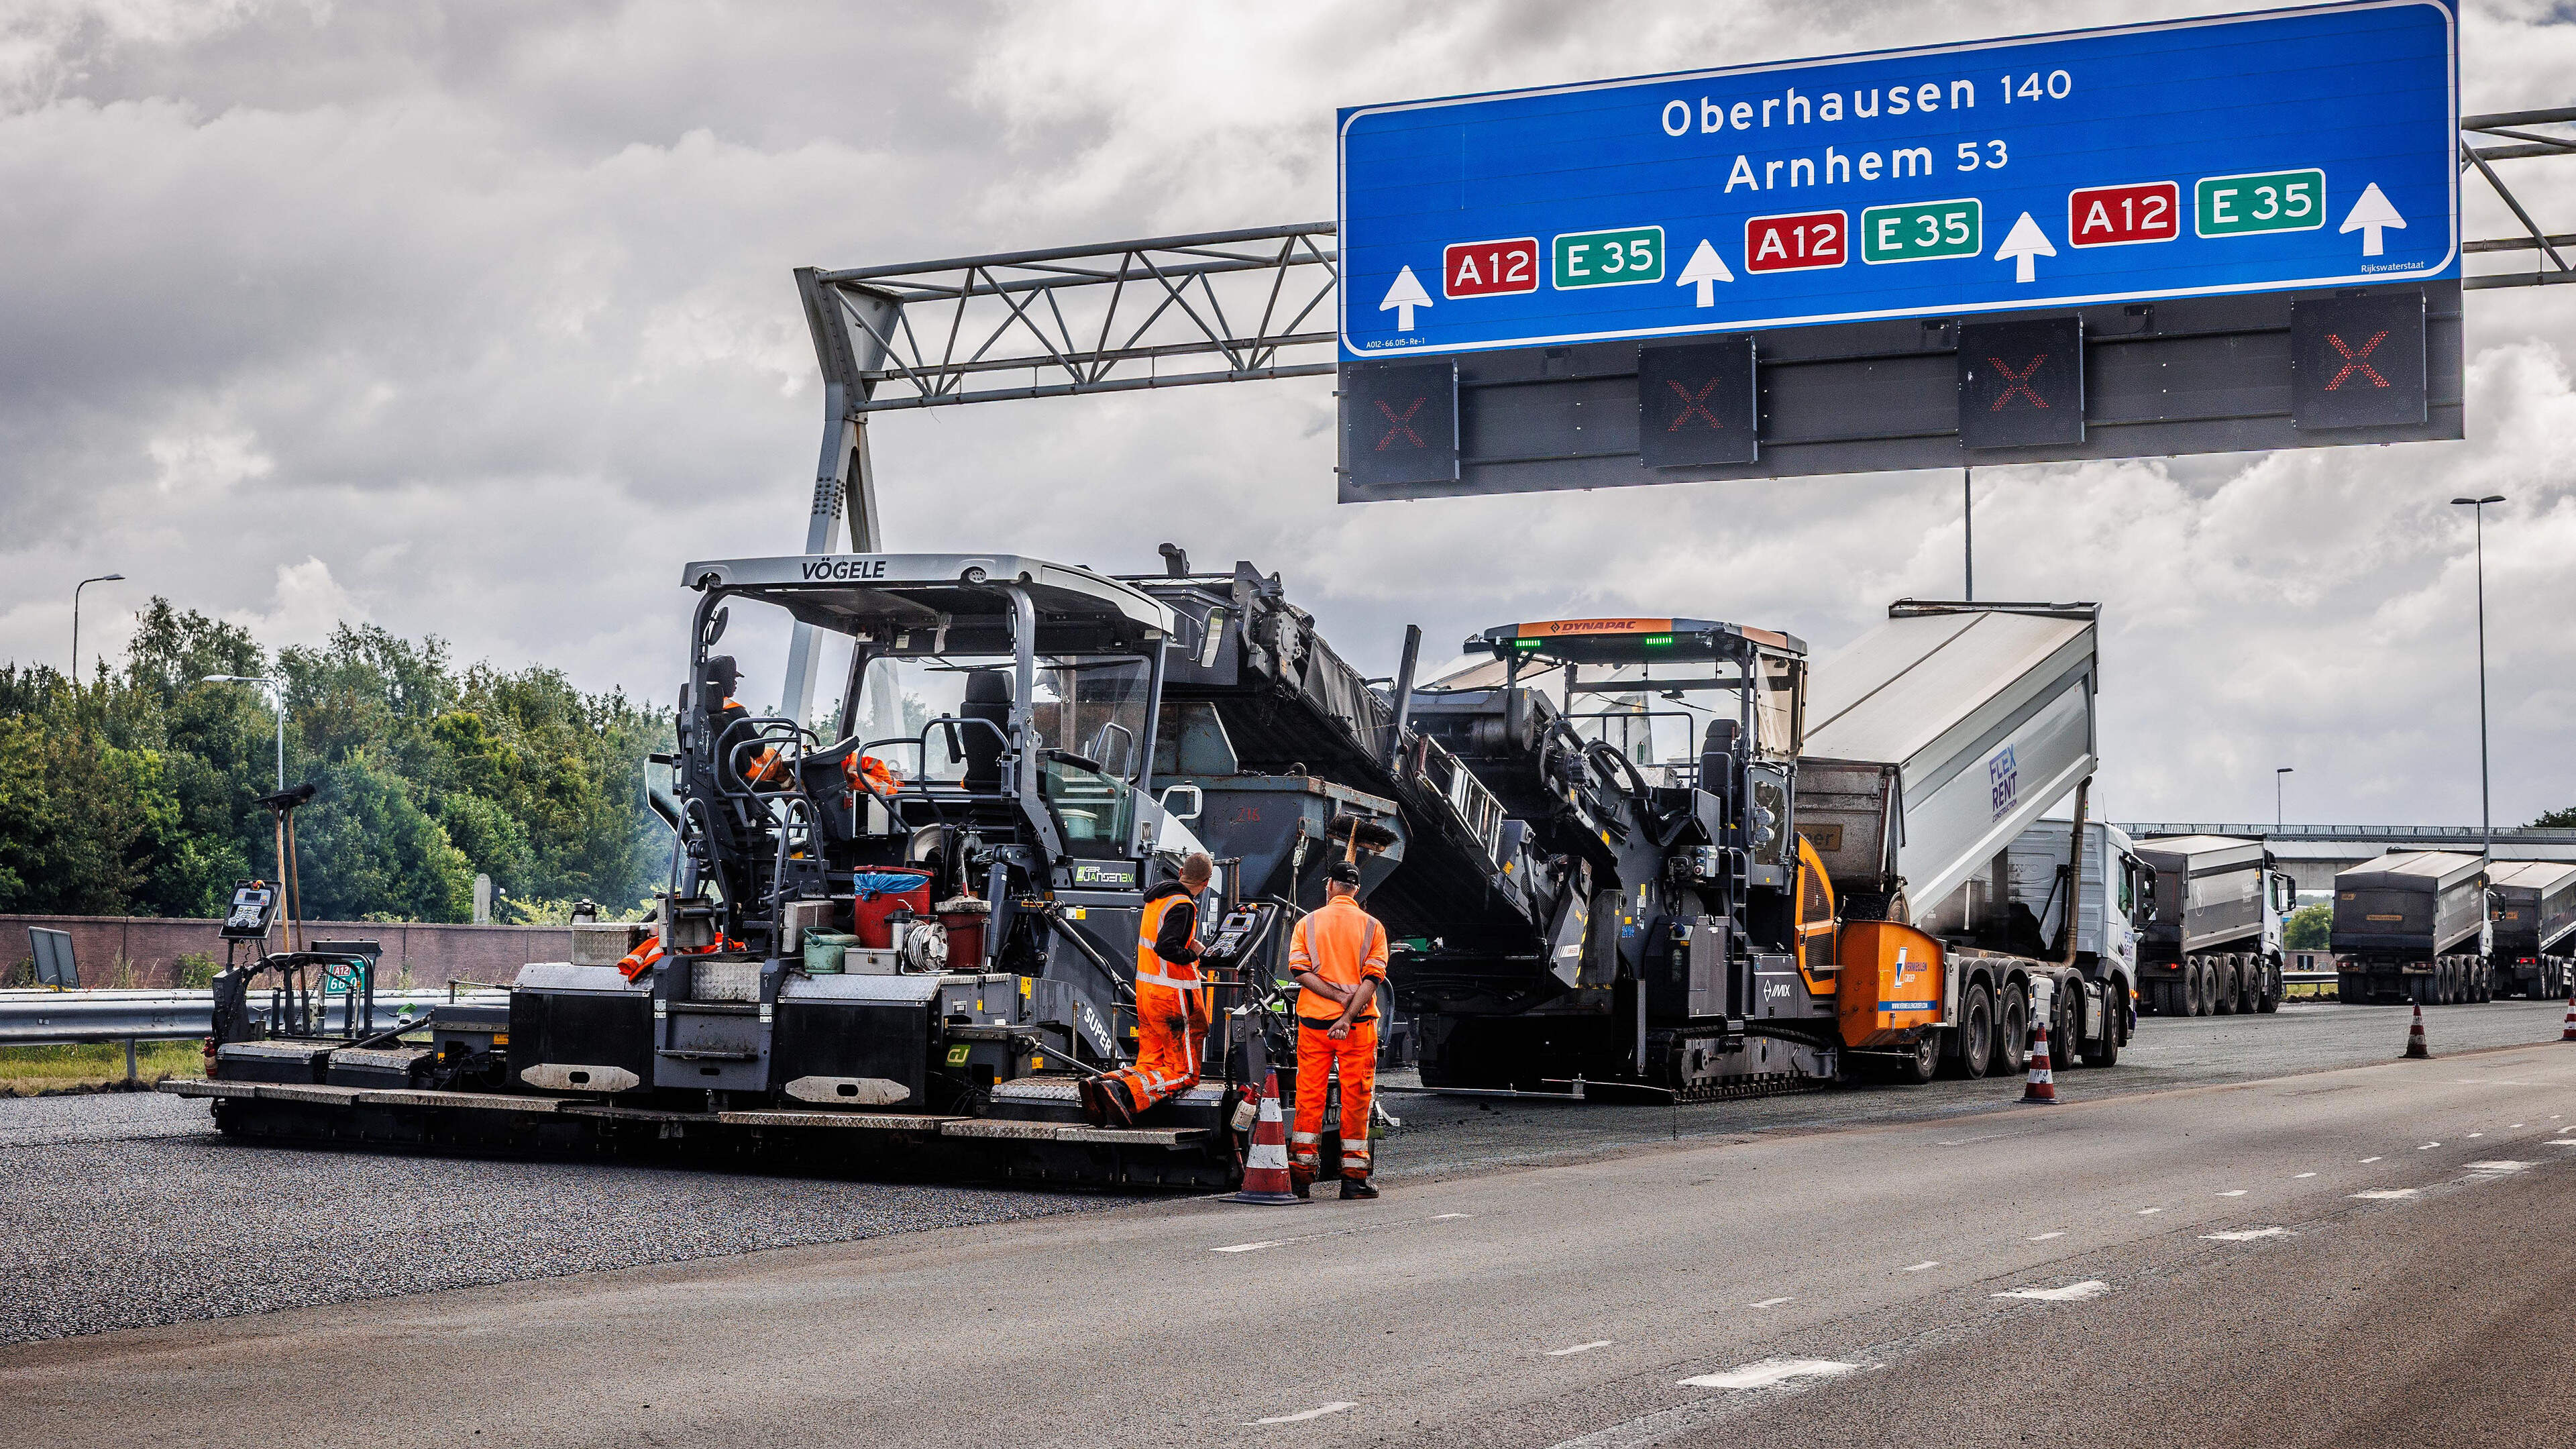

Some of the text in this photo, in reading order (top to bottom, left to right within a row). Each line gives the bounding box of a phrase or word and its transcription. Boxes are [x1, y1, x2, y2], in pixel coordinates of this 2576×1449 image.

[1662, 69, 2072, 137] Oberhausen 140
[1725, 140, 2008, 193] Arnhem 53
[2081, 182, 2312, 235] A12 E 35
[1756, 211, 1970, 262] A12 E 35
[1454, 239, 1654, 287] A12 E 35
[2361, 260, 2424, 274] Rijkswaterstaat
[802, 557, 887, 580] VÖGELE
[1562, 621, 1636, 631] DYNAPAC
[1989, 743, 2017, 785] FLEX
[1992, 770, 2018, 812] RENT
[335, 966, 350, 975] A12
[1083, 1006, 1112, 1057] SUPER
